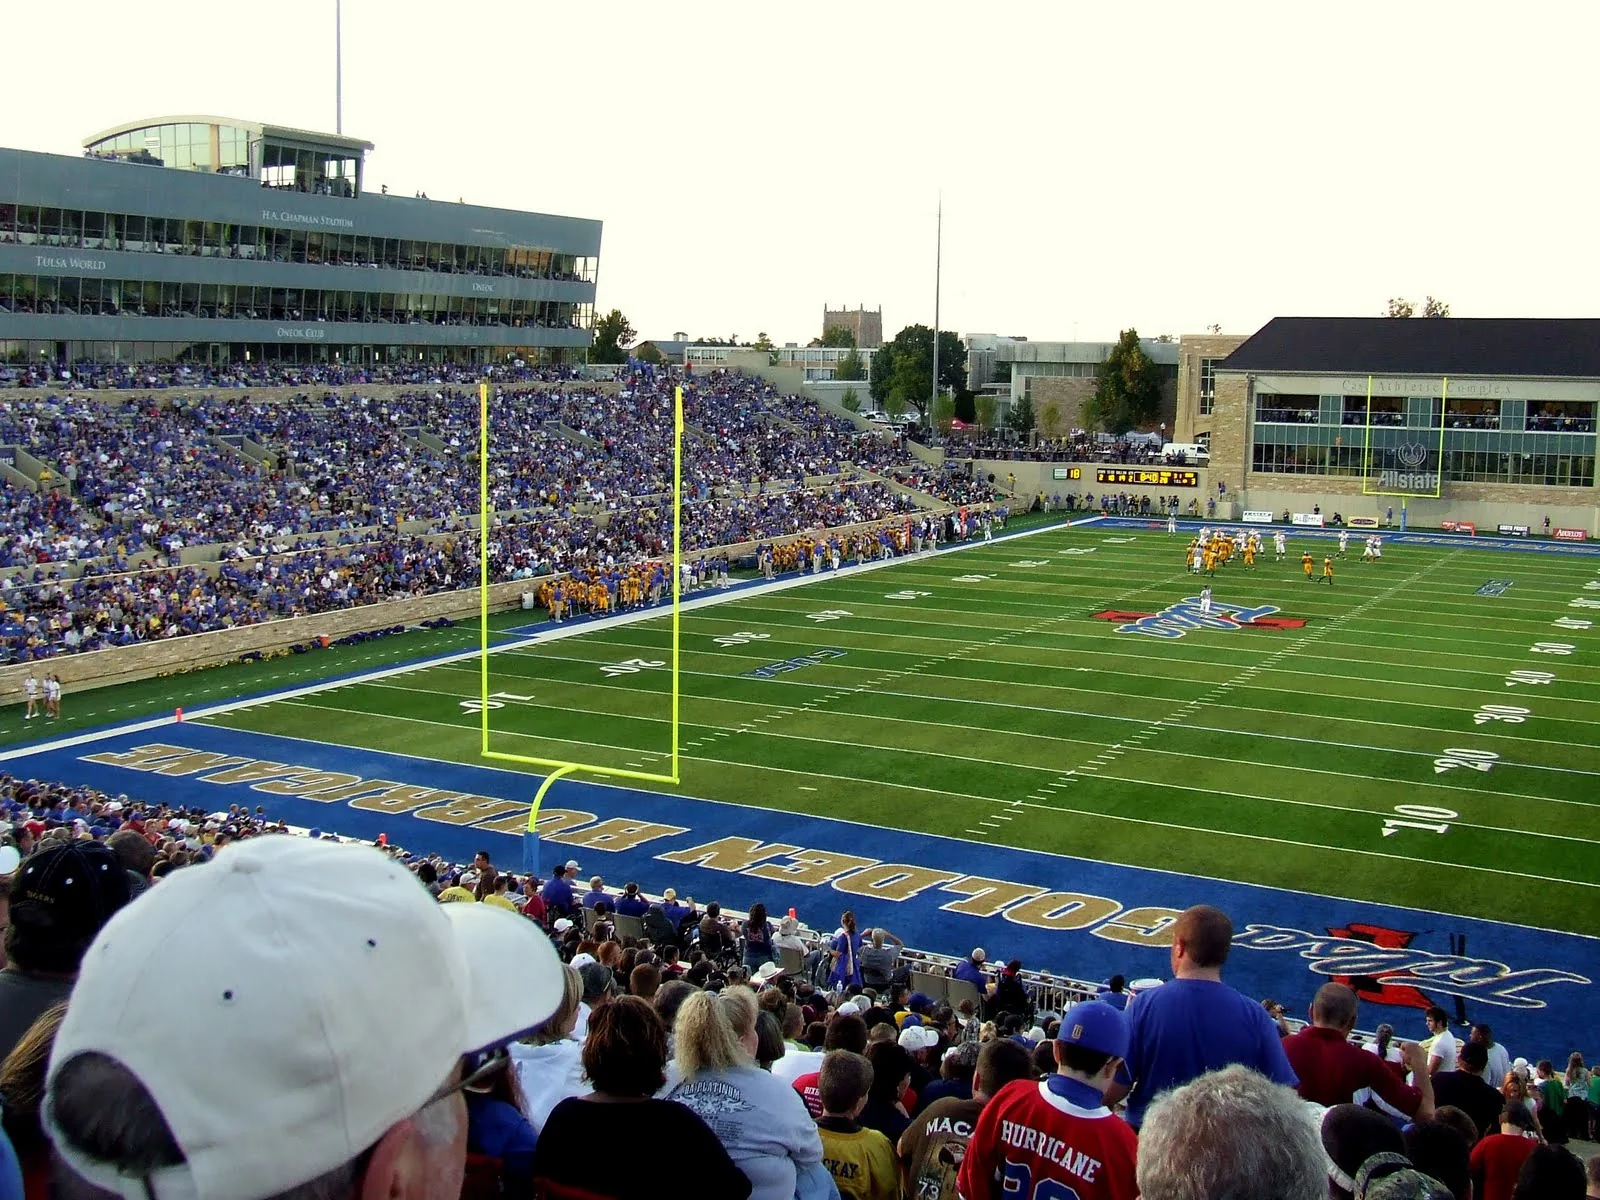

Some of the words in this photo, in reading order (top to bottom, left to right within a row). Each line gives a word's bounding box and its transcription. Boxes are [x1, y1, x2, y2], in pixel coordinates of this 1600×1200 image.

[280, 211, 318, 225] CHAPMAN
[320, 216, 353, 228] STADIUM
[35, 255, 67, 269] TULSA
[69, 257, 106, 270] WORLD
[1375, 381, 1440, 394] Athletic
[1446, 381, 1511, 397] Complex
[1377, 470, 1439, 490] Allstate
[713, 631, 771, 645] 30
[600, 658, 667, 674] 20
[1505, 670, 1555, 685] 40
[459, 691, 536, 710] 10
[1474, 704, 1530, 724] 30
[1434, 748, 1499, 772] 20
[1382, 804, 1459, 834] 10
[76, 742, 691, 852] HURRICANE
[652, 836, 1184, 948] GOLDEN
[925, 1116, 976, 1139] MAC
[1001, 1119, 1102, 1184] HURRICANE
